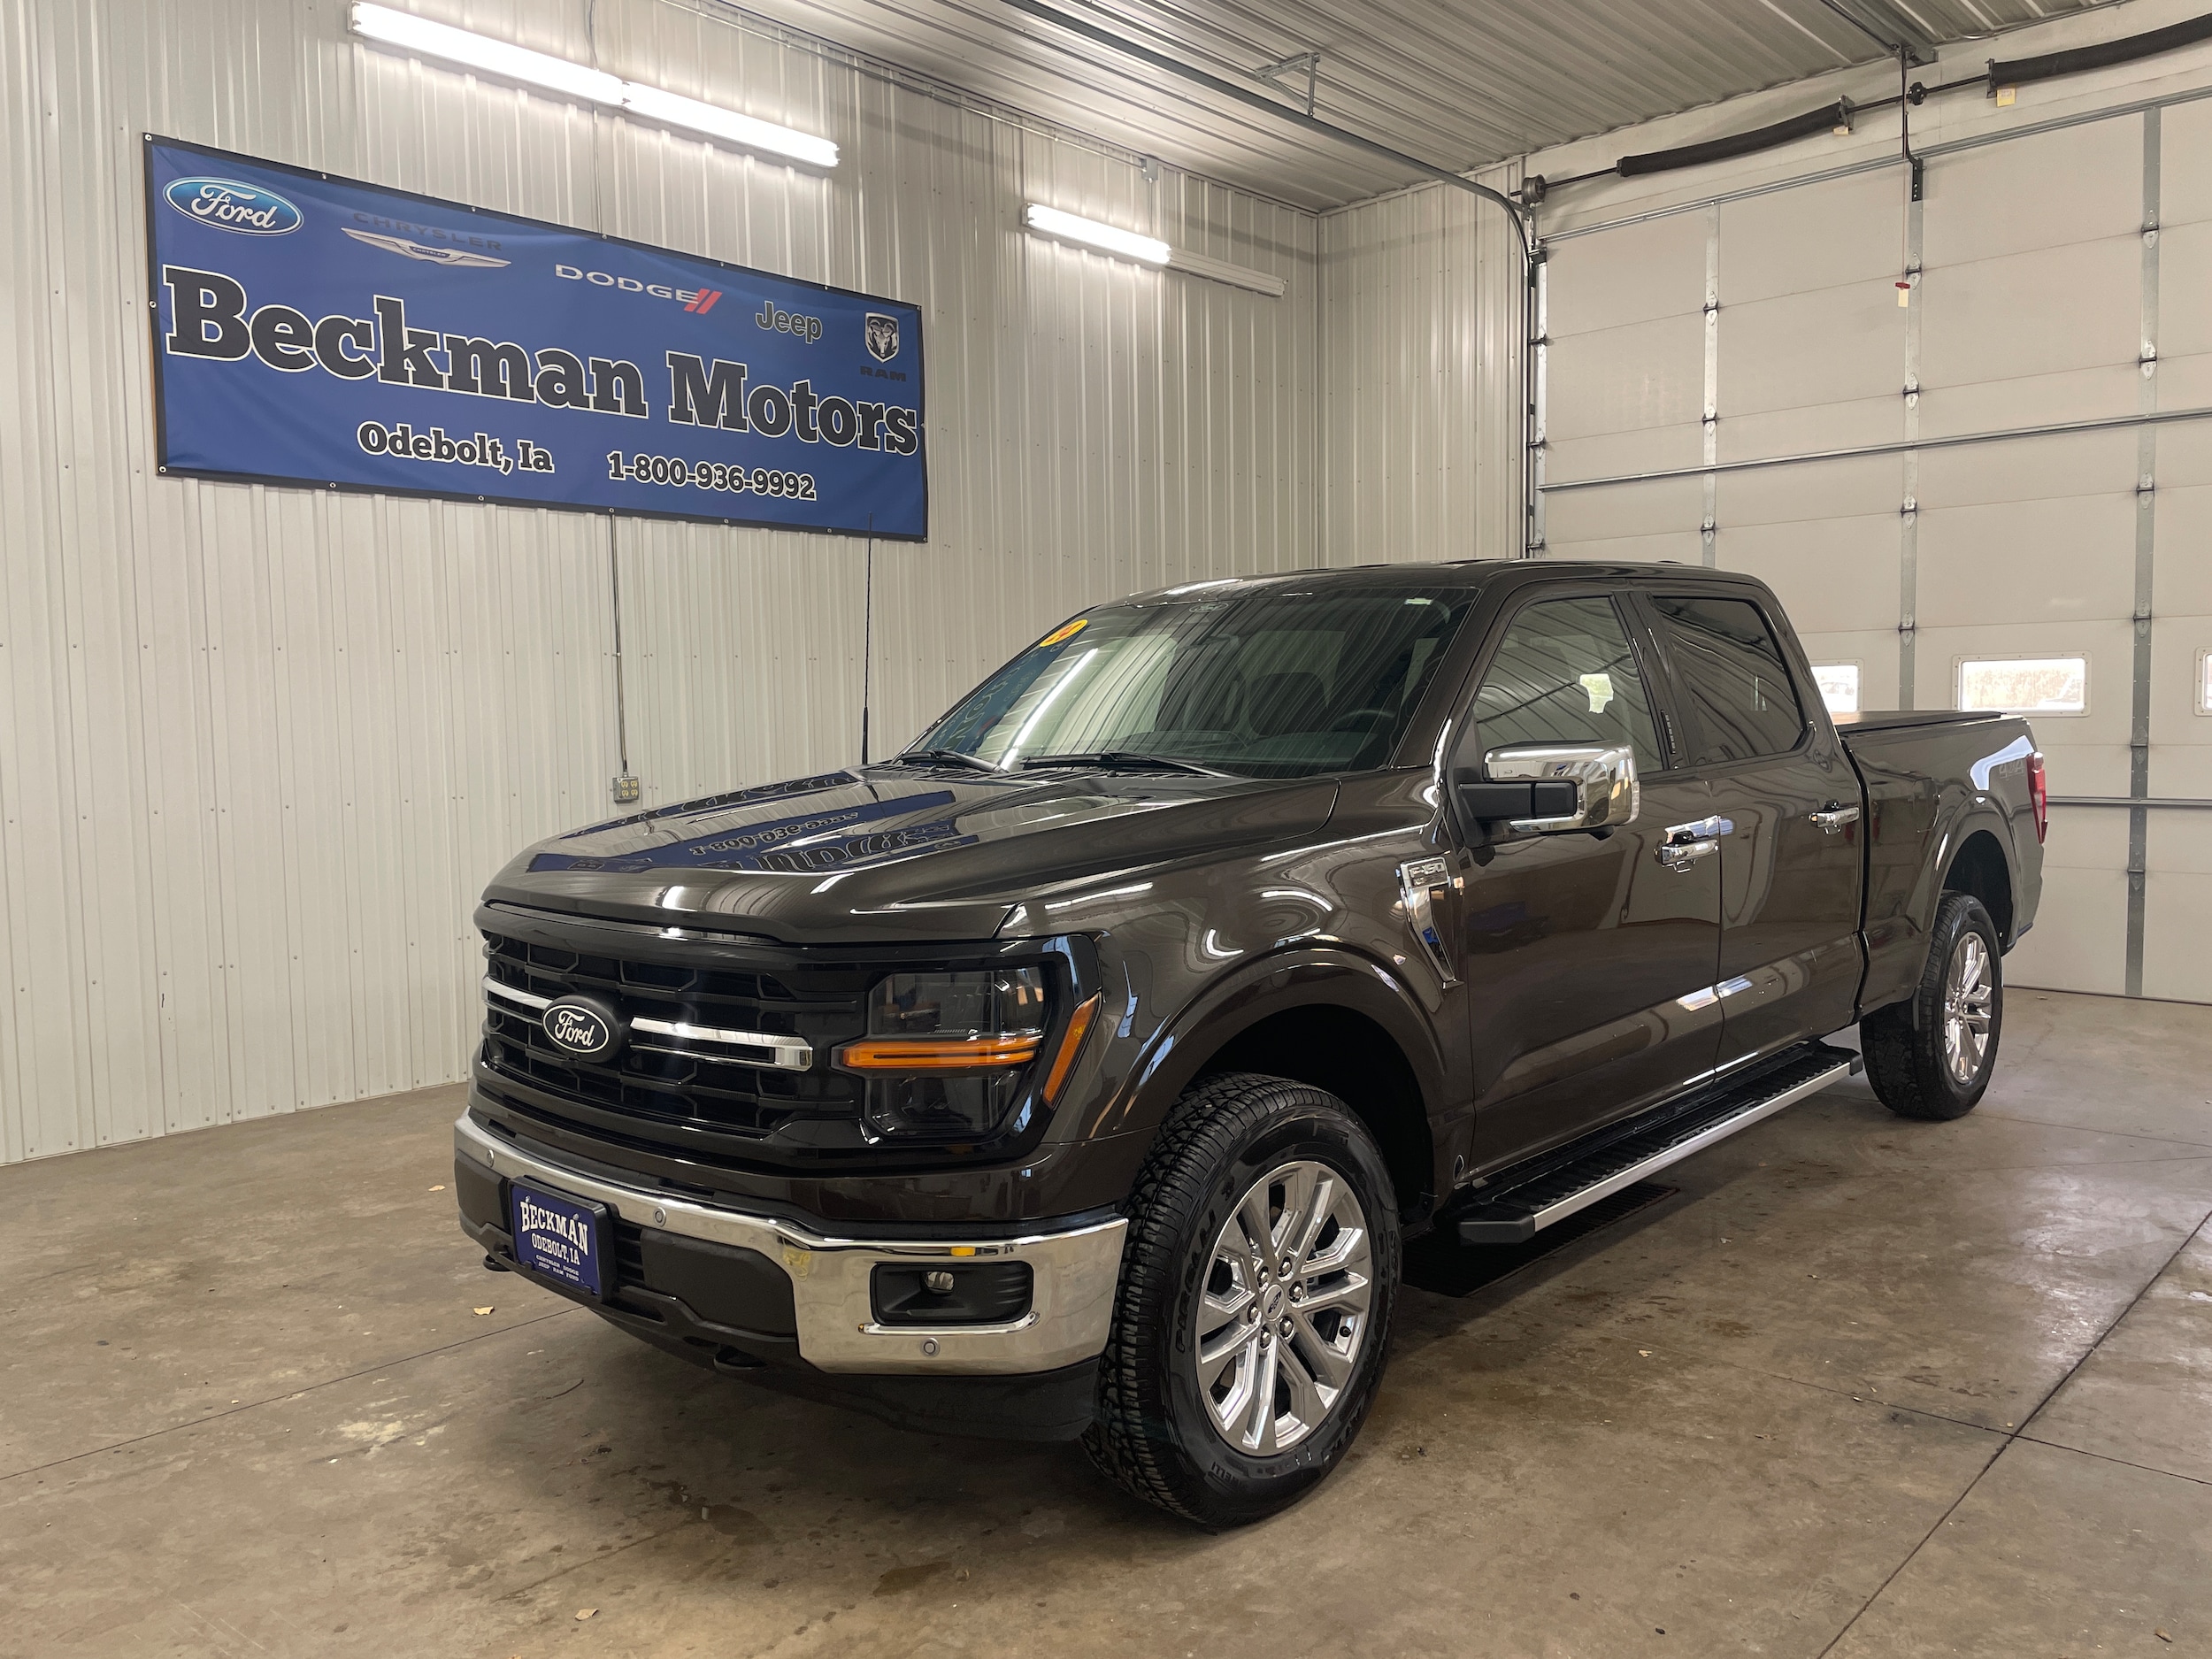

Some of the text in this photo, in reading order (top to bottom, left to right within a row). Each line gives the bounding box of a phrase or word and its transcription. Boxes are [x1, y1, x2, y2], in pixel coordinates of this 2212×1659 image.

[190, 182, 278, 230] Ford
[353, 211, 503, 252] CHRYSLER
[555, 264, 699, 304] DODGE
[755, 300, 823, 344] Jeep
[163, 264, 918, 457] Beckman Motors
[860, 365, 907, 382] RAM
[357, 420, 555, 475] Odebolt, Ia
[606, 449, 818, 502] 1-800-936-9992
[554, 1010, 595, 1047] Ford
[519, 1201, 588, 1256] BECKMAN
[531, 1233, 580, 1266] ODEBOLT, IA
